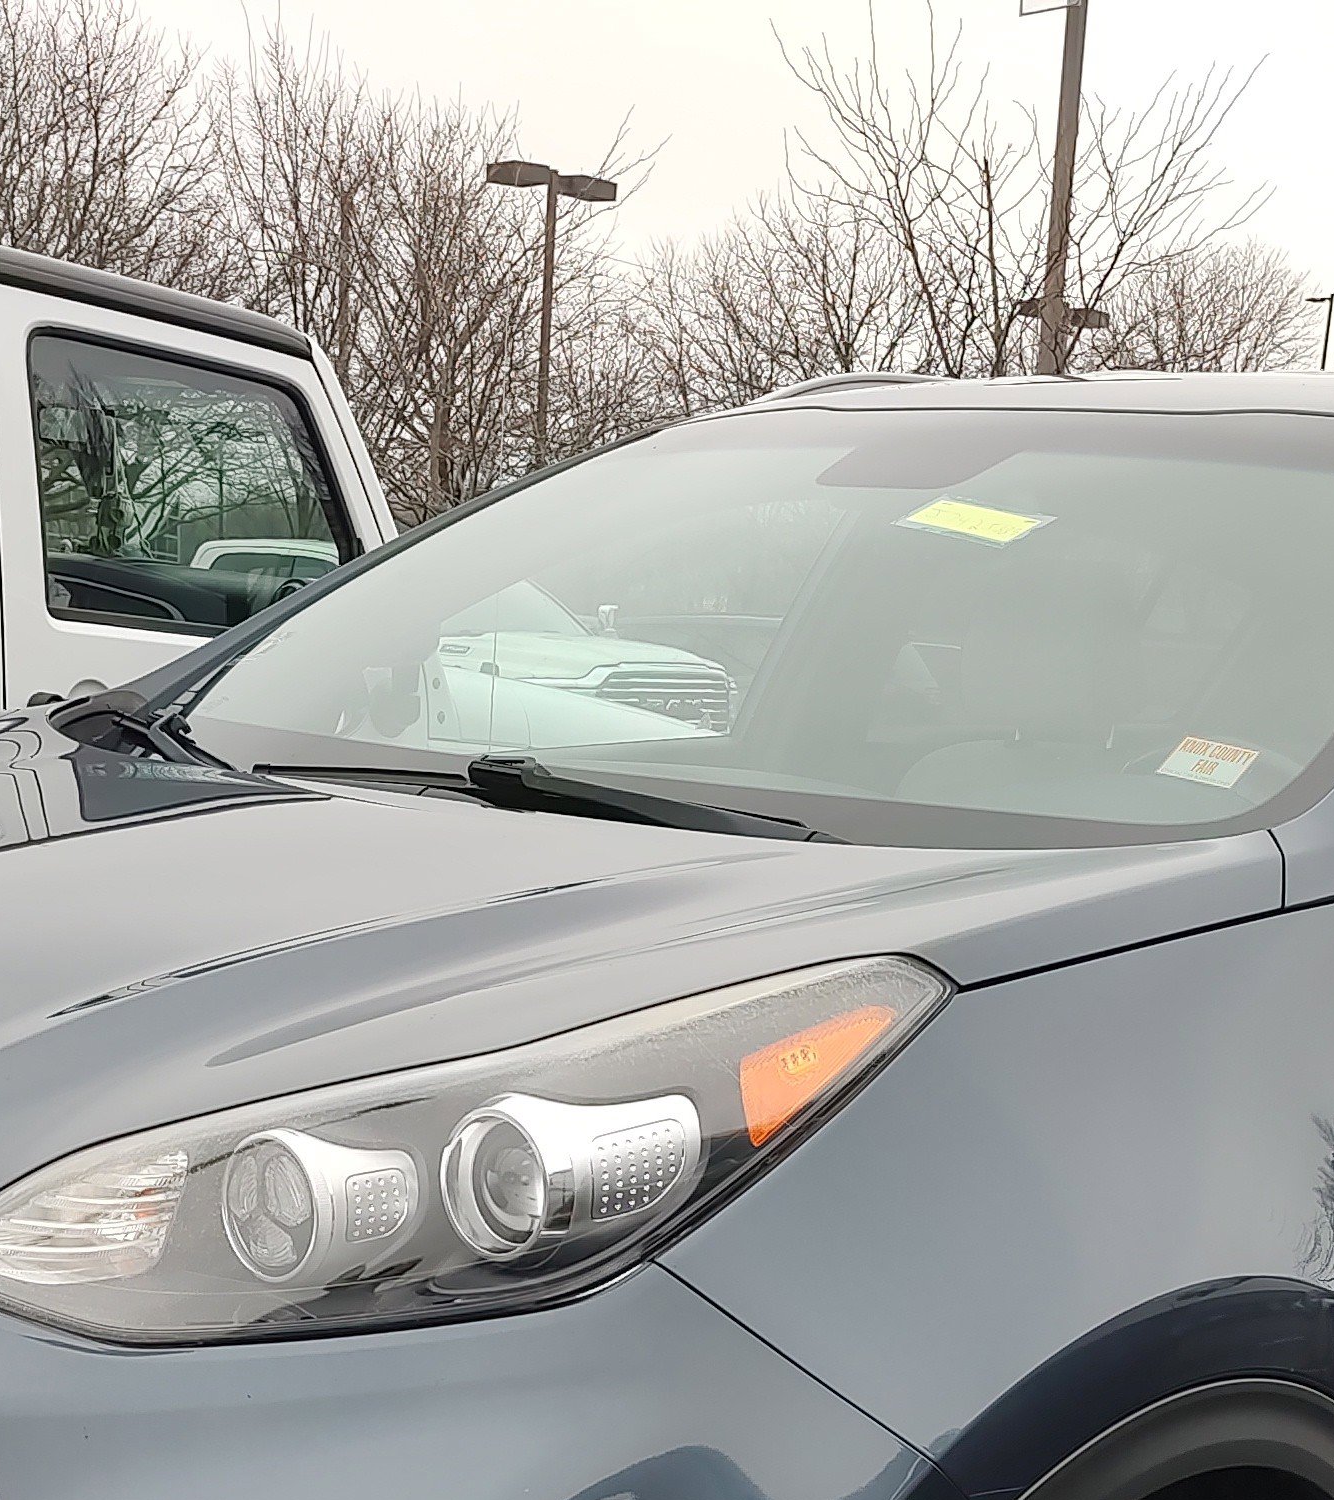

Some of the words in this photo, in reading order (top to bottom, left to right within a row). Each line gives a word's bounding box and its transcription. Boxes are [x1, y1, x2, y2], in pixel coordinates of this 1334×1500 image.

[1180, 739, 1209, 756] KNOX
[1210, 745, 1255, 765] COUNTY
[1191, 759, 1219, 775] FAIR
